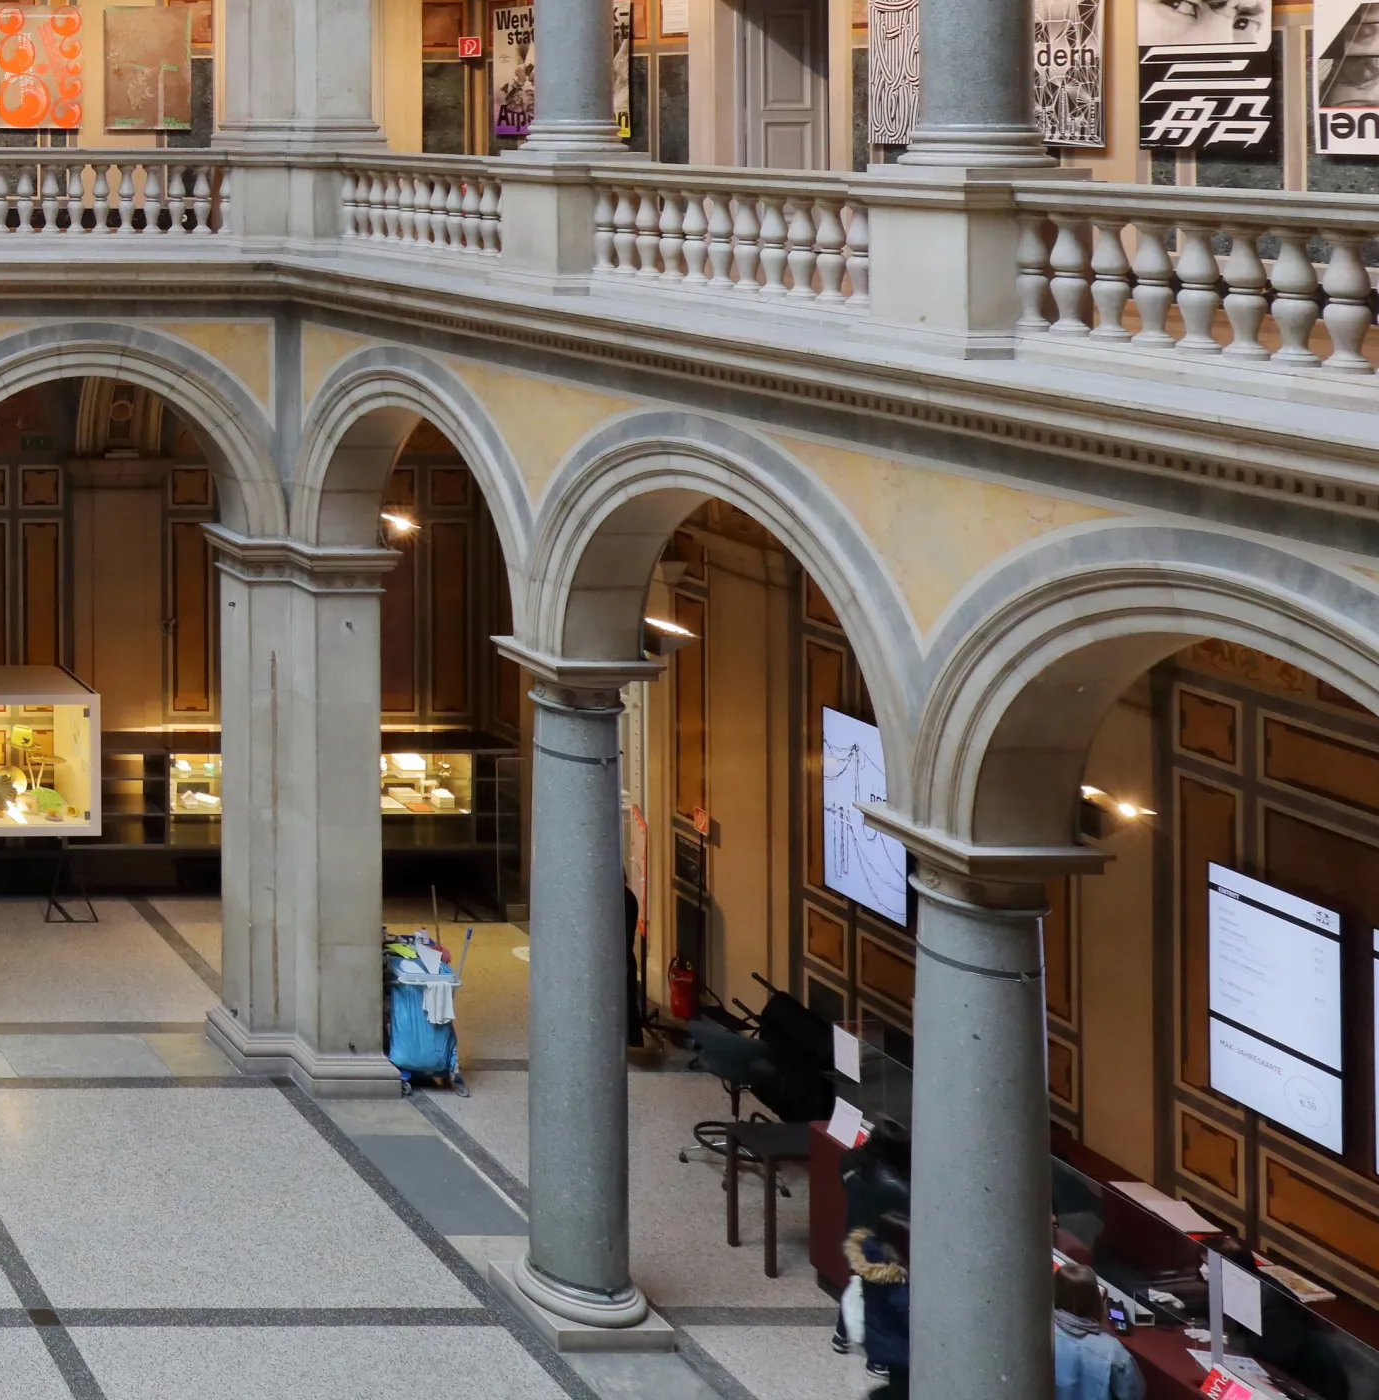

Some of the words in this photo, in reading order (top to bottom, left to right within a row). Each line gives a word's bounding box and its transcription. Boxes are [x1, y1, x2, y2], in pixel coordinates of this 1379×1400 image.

[1037, 44, 1094, 67] dern
[1316, 917, 1331, 926] MAK
[1219, 1038, 1283, 1075] MAK-JAHRESKARTE
